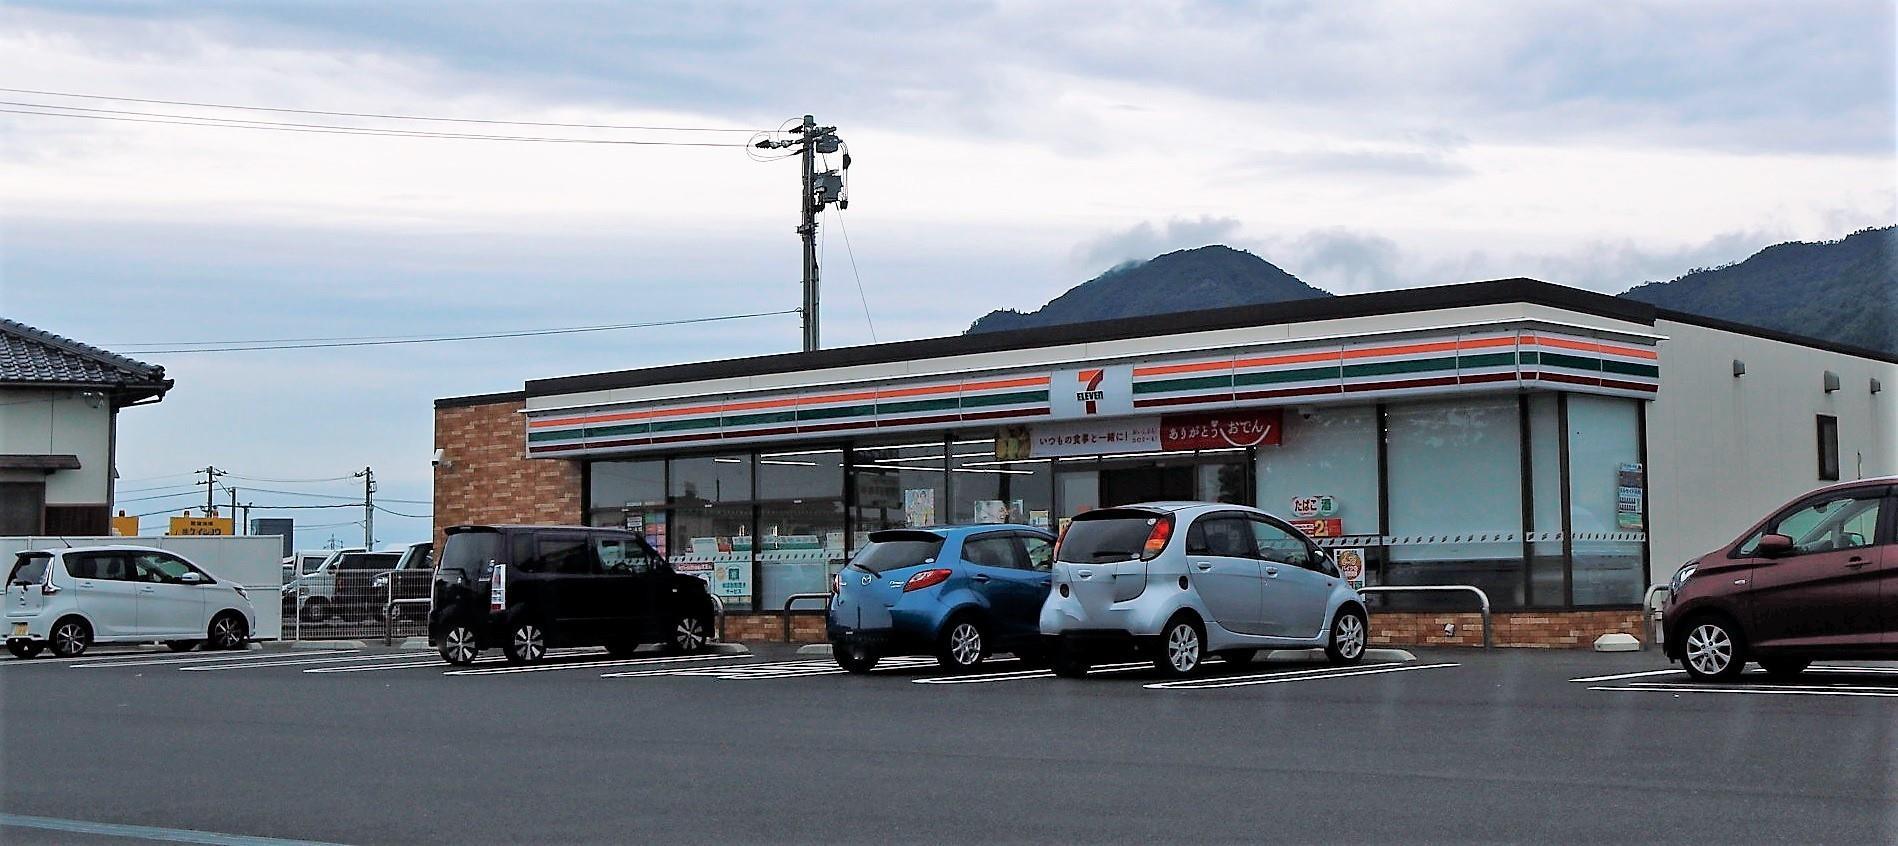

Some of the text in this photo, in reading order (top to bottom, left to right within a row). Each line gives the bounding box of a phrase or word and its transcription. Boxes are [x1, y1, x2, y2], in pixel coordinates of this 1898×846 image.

[1078, 369, 1104, 414] 7
[1169, 425, 1218, 440] ありがとう
[1228, 420, 1264, 434] おでん
[1295, 499, 1318, 512] たばこ
